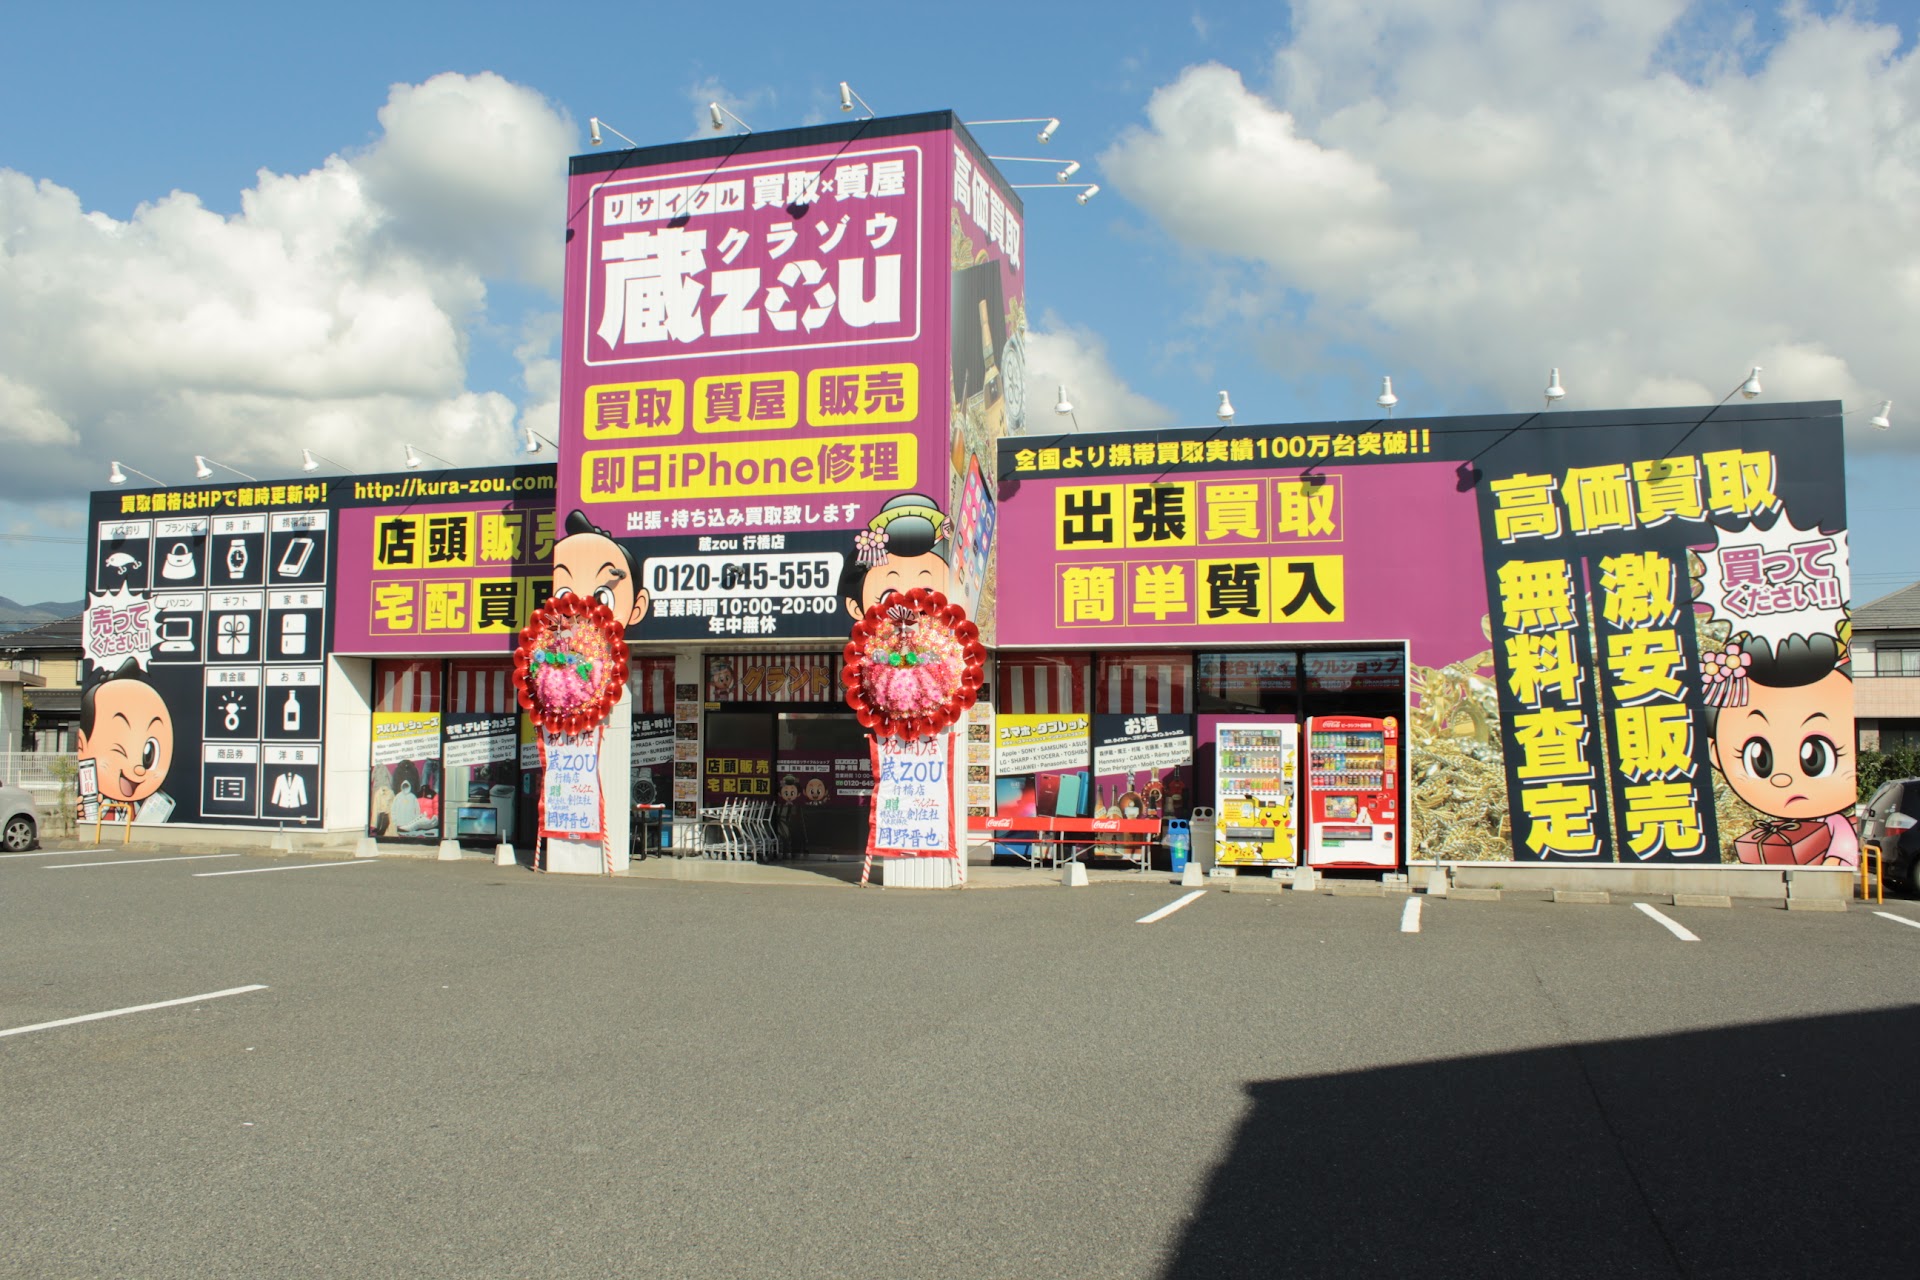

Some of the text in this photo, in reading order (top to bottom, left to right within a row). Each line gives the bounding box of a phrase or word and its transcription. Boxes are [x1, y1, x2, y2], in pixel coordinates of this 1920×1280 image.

[610, 187, 739, 218] リサイクル
[953, 143, 1020, 271] 高価買取
[716, 212, 898, 265] クラゾウ
[704, 379, 786, 424] 質屋
[819, 371, 905, 417] 販売
[595, 387, 672, 431] 買取
[590, 441, 900, 495] 即日iPhone修理
[121, 483, 328, 514] 買取価格はHPで随時更新中!
[1489, 448, 1783, 544] 高価買取
[282, 516, 316, 528] 携帯電話
[626, 502, 860, 531] 出張・持ち込み買取致します
[1062, 479, 1337, 545] 出張買取
[110, 525, 140, 537] バス釣り
[164, 522, 199, 533] ブランド品
[698, 534, 785, 552] 蔵zou 行橋店
[1722, 542, 1832, 588] 買って
[652, 560, 830, 592] 0120-645-555
[165, 597, 193, 608] パソコン
[222, 596, 249, 607] ギフト
[1061, 562, 1337, 623] 簡単質入
[90, 604, 149, 637] 売って
[708, 615, 777, 635] 年中無休
[219, 671, 246, 683] 貴金属
[742, 665, 846, 696] グランド
[1497, 558, 1601, 860] 無料査定
[1600, 551, 1705, 860] 激安販売
[1000, 717, 1089, 740] スマホ・タブレット
[1123, 715, 1160, 735] お酒
[217, 748, 243, 760] 商品券
[635, 741, 652, 749] PRADA
[1001, 740, 1087, 759] Apple SONY SAMSUNG ASUS
[707, 759, 769, 774] 店頭販売
[1010, 756, 1030, 764] SHARP
[1033, 752, 1060, 762] KYOCERA
[1064, 748, 1088, 757] TOSHIBA
[1098, 757, 1126, 766] Hennessy
[1129, 753, 1151, 762] CAMUS
[1170, 748, 1190, 756] Martin
[1098, 766, 1112, 774] Dom
[1155, 757, 1181, 766] Chandon
[999, 766, 1011, 774] NEC
[1014, 763, 1037, 772] HUAWEI
[1040, 760, 1068, 769] Panasonic
[707, 779, 769, 793] 宅配買取
[893, 784, 926, 797] 行橋店
